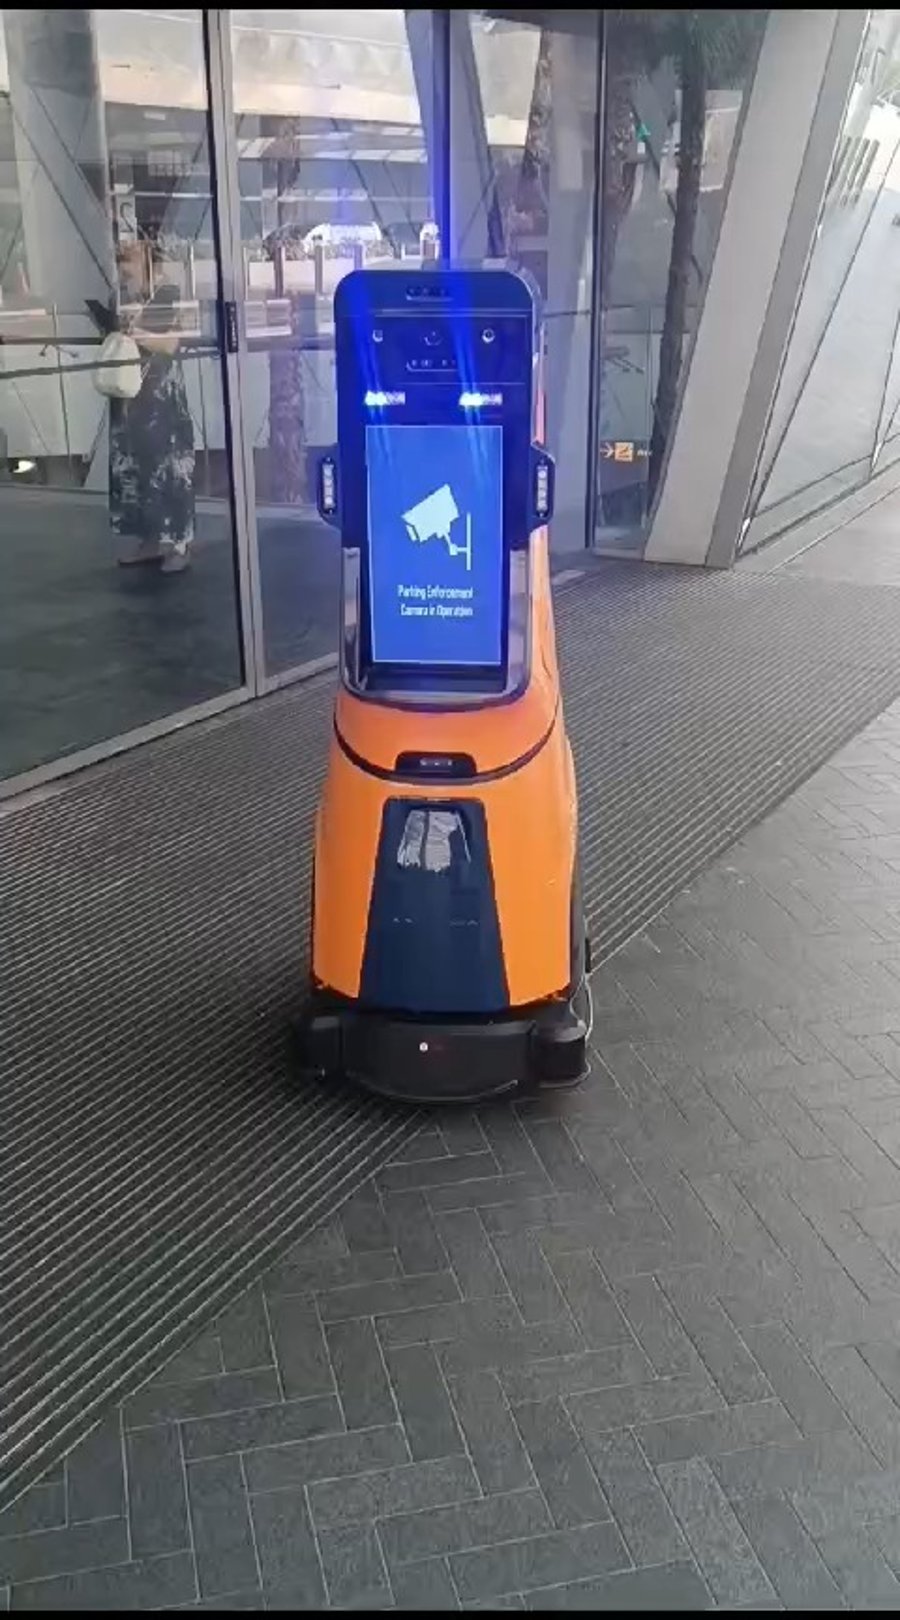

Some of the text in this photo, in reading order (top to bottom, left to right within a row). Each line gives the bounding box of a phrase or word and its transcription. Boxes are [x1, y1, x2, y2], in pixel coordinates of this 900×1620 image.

[397, 585, 473, 600] Parking Enforcement
[401, 603, 473, 618] Camera in Operation
